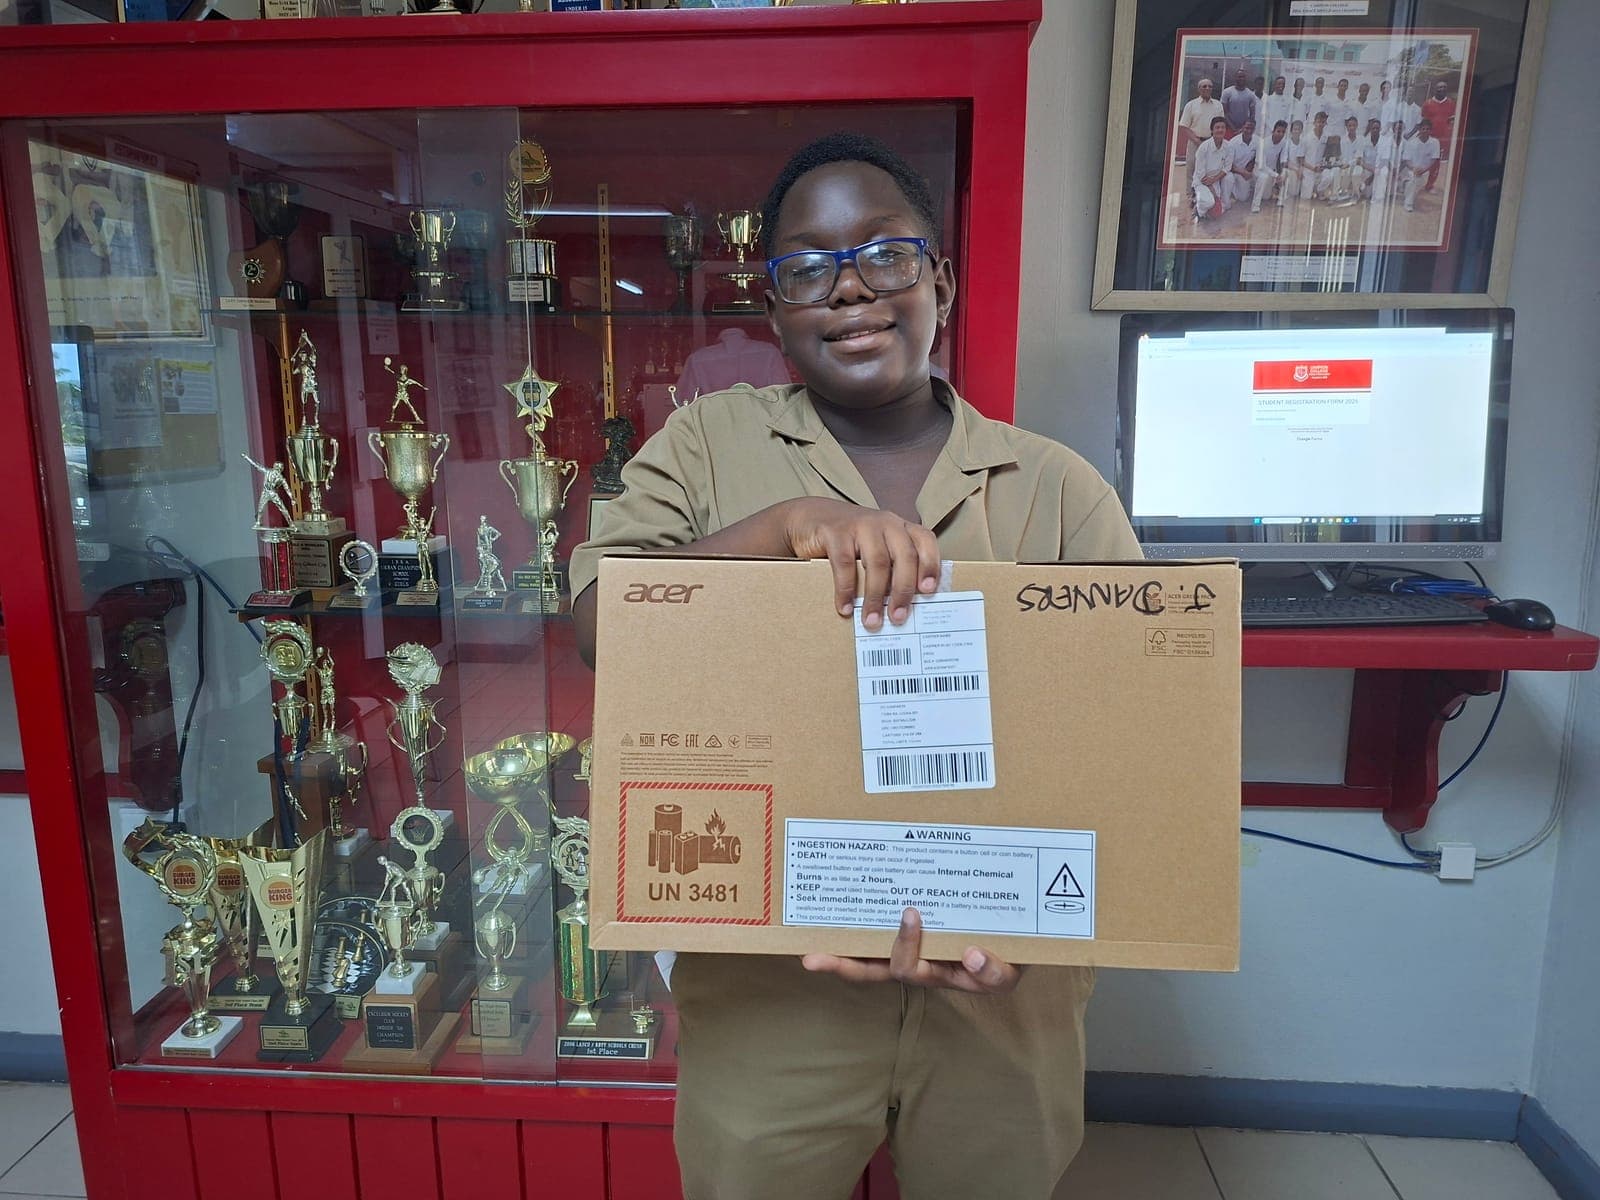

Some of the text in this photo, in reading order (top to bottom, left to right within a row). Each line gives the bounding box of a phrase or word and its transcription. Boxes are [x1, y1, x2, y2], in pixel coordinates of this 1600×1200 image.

[624, 583, 704, 604] acer
[917, 830, 971, 841] WARNING
[797, 841, 845, 849] INGESTION
[848, 842, 889, 851] HAZARD:
[796, 873, 822, 881] Burns
[938, 868, 970, 876] Internal
[973, 869, 1013, 878] Chemical
[648, 883, 739, 903] UN 3481
[890, 886, 909, 895] OUT
[927, 889, 959, 897] REACH
[972, 891, 1019, 900] CHILDREN
[819, 894, 863, 903] immediate
[866, 896, 899, 906] medical
[902, 898, 939, 908] attention
